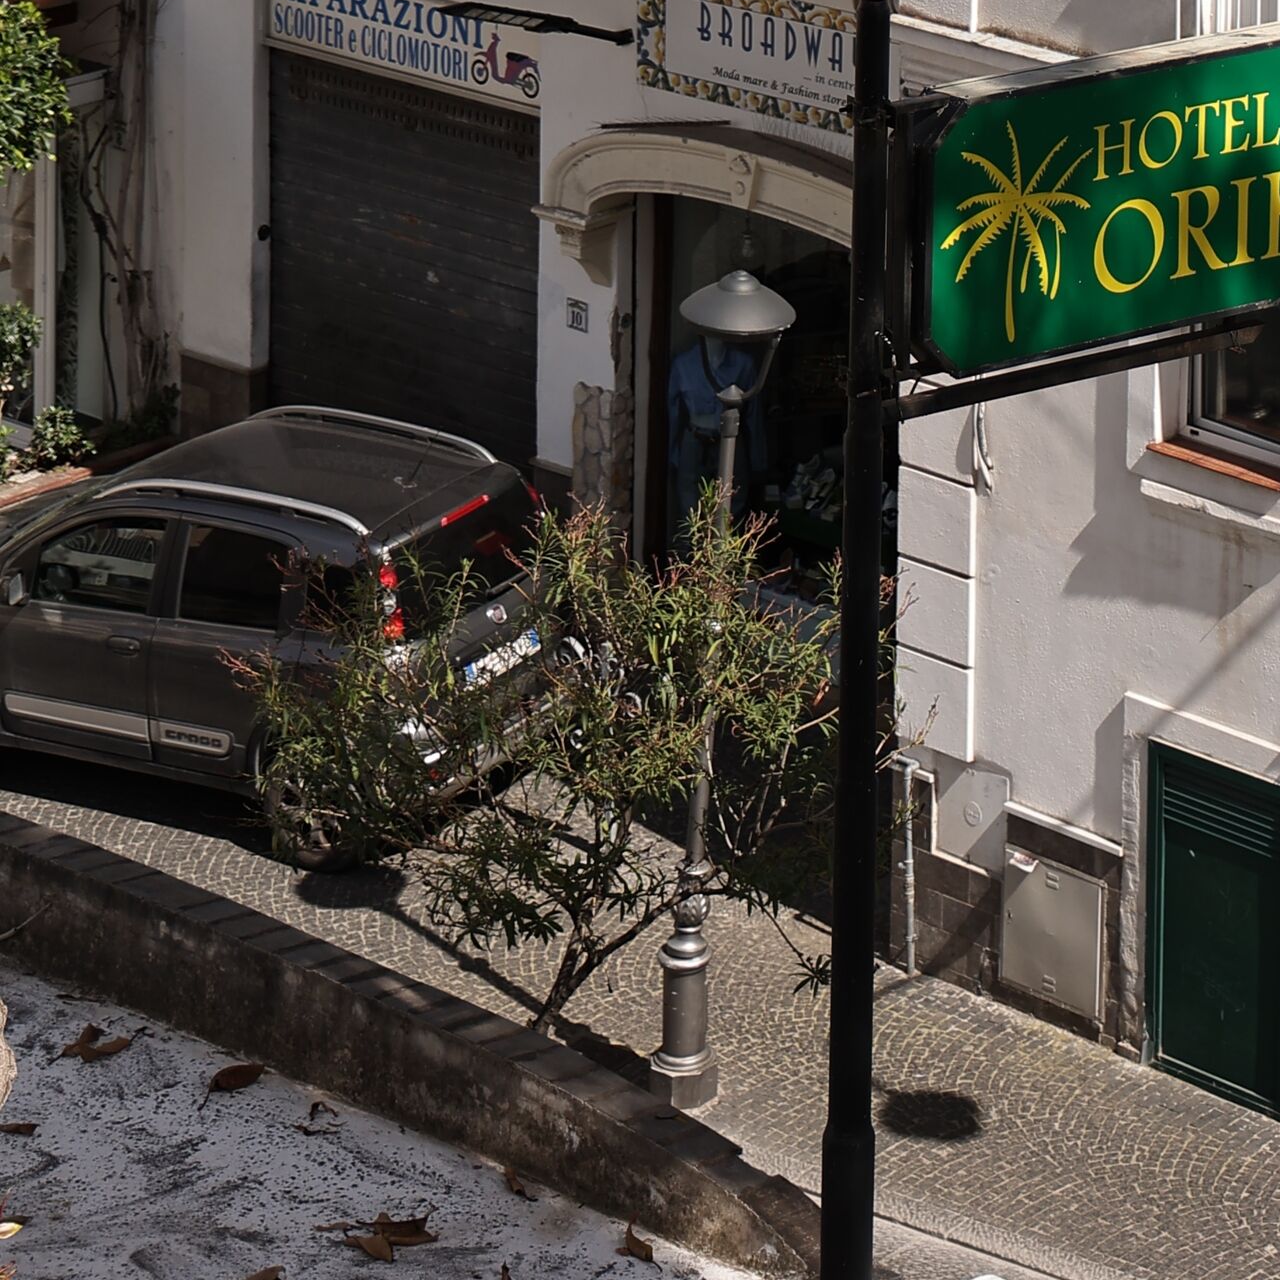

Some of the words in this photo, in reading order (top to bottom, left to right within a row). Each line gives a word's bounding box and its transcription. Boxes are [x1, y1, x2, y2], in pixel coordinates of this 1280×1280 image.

[274, 2, 344, 50] SCOOTER
[349, 30, 358, 52] e
[361, 25, 468, 82] CICLOMOTORI
[712, 66, 740, 81] Moda
[743, 75, 768, 88] mare
[770, 80, 778, 91] &
[780, 82, 820, 101] Fashion
[822, 95, 847, 107] store
[815, 72, 825, 84] in
[828, 77, 855, 91] centr
[571, 310, 582, 326] 10
